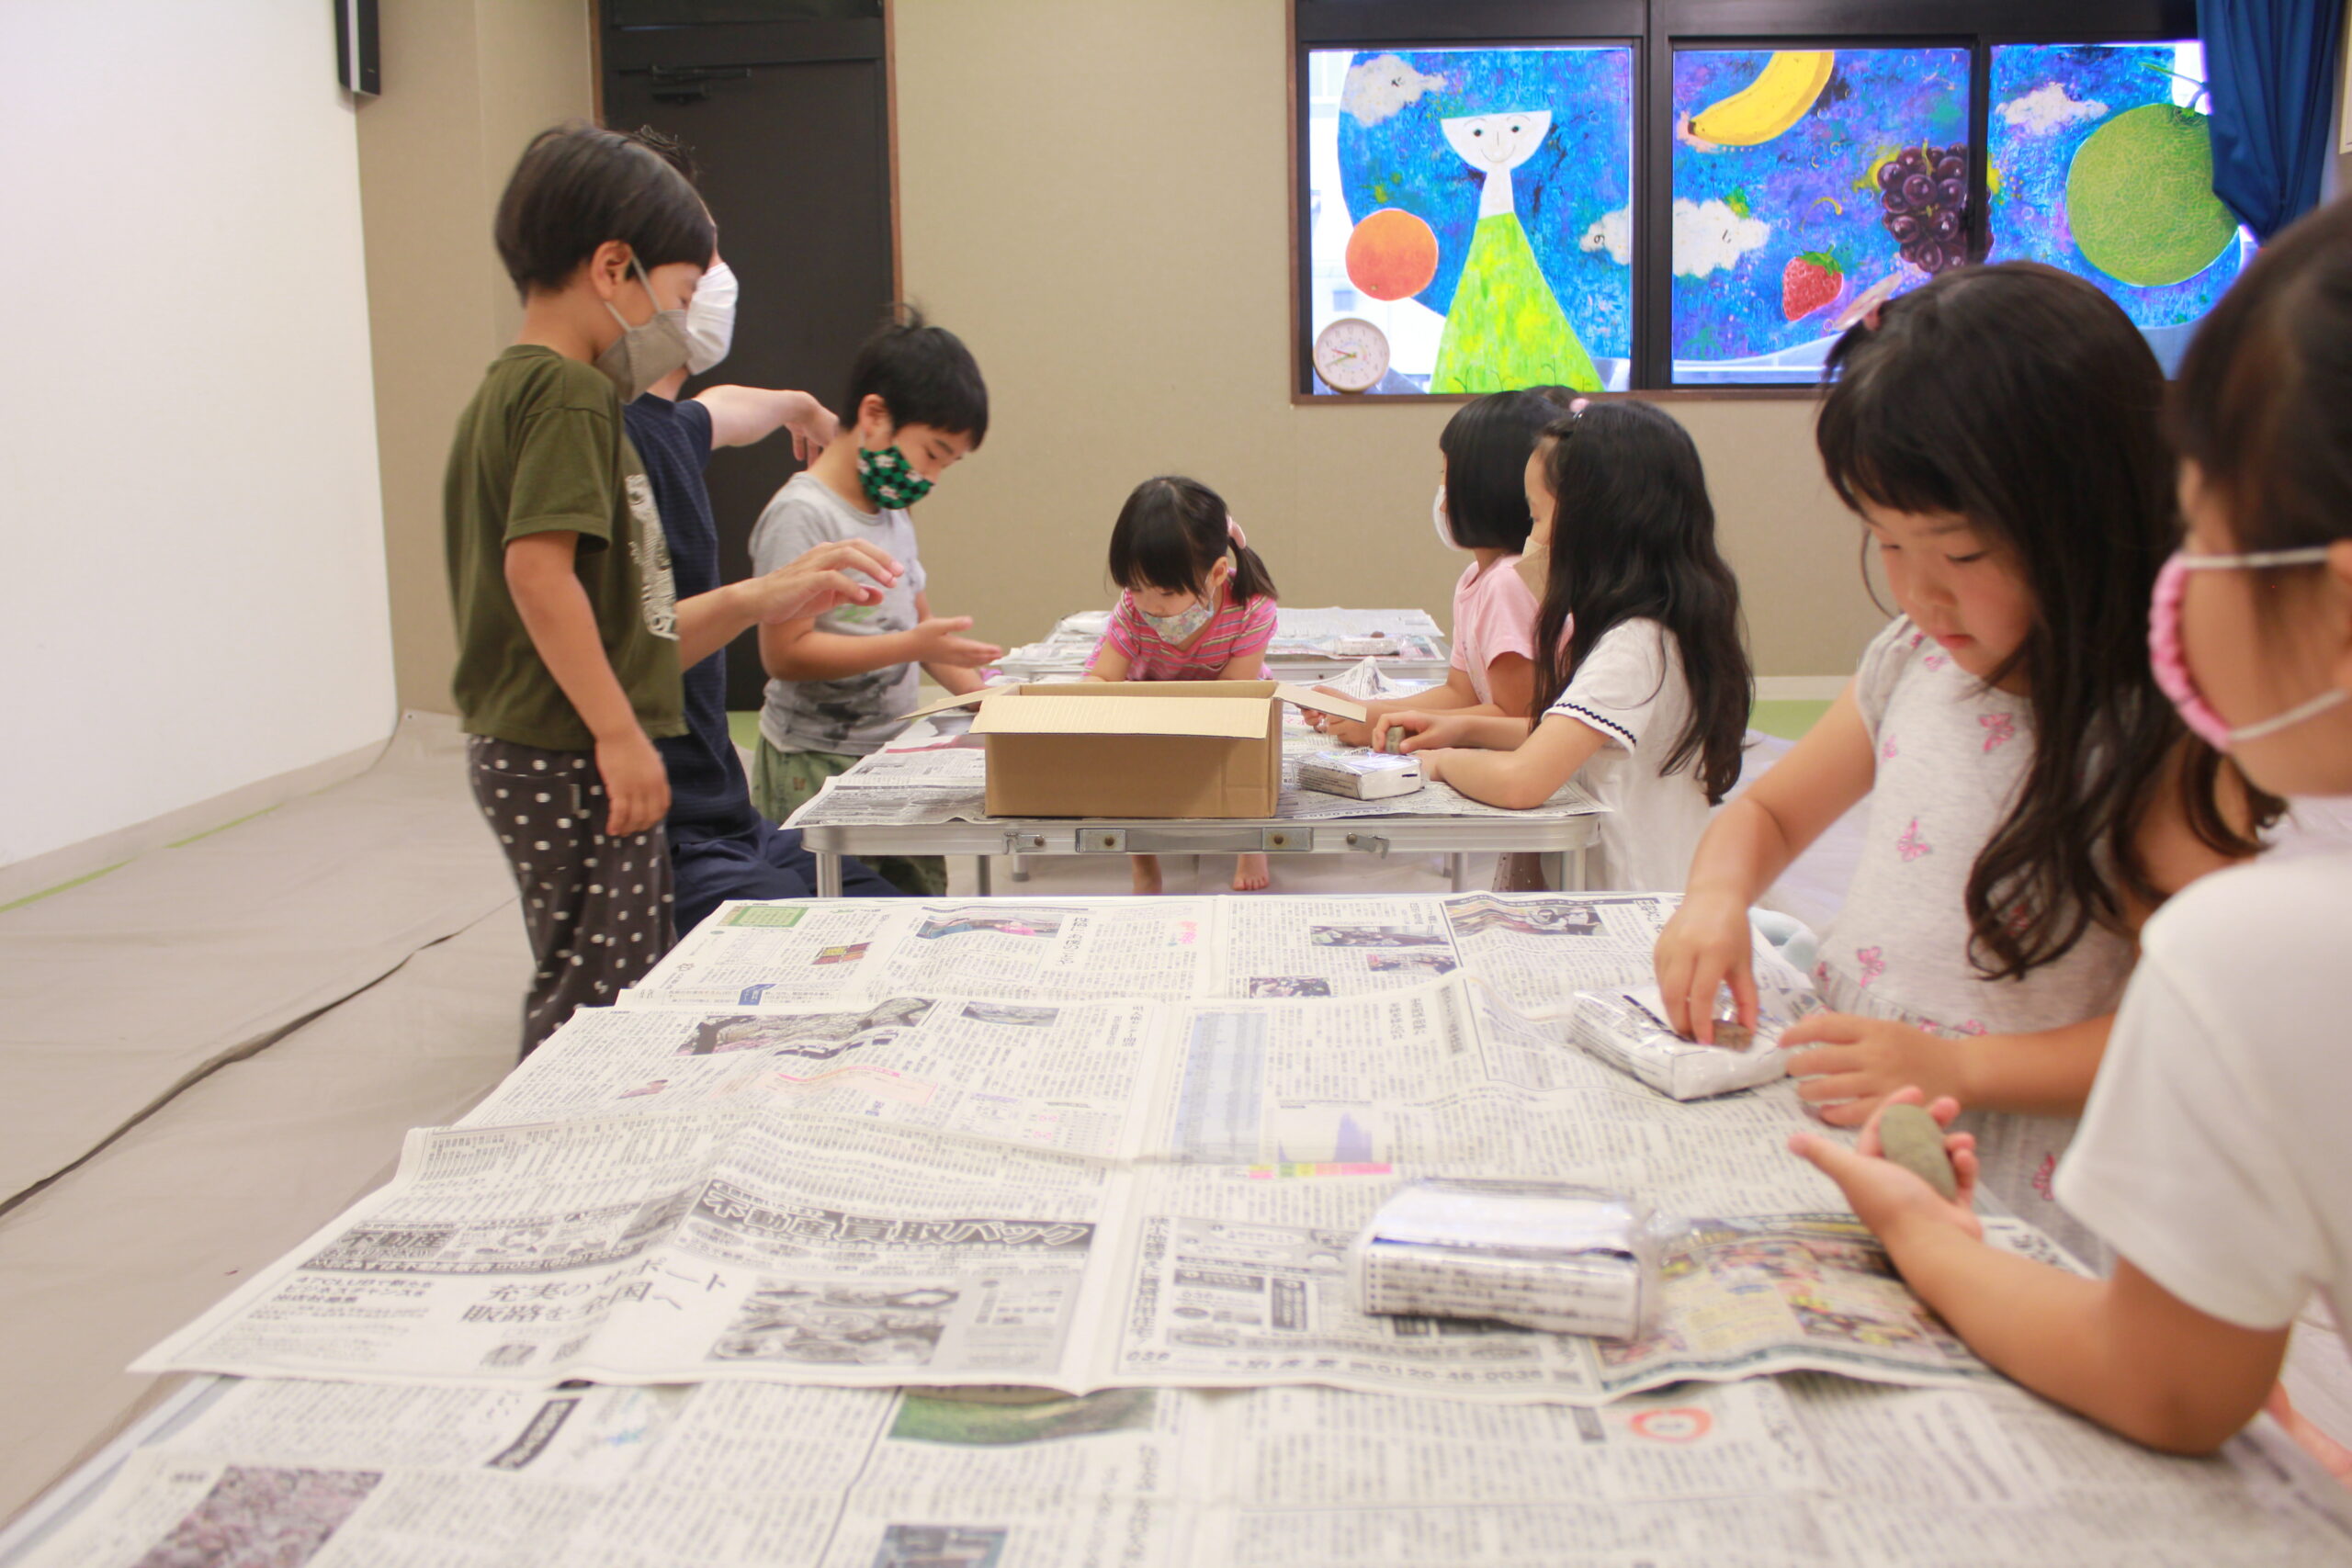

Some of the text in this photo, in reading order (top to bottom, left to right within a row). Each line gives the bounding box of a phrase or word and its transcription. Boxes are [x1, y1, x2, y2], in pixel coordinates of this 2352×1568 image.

[701, 1189, 1090, 1247] 不動産買取パック
[339, 1231, 454, 1249] 不動産
[487, 1257, 728, 1302] 充実のサポート
[459, 1281, 683, 1323] 販路を全国へ
